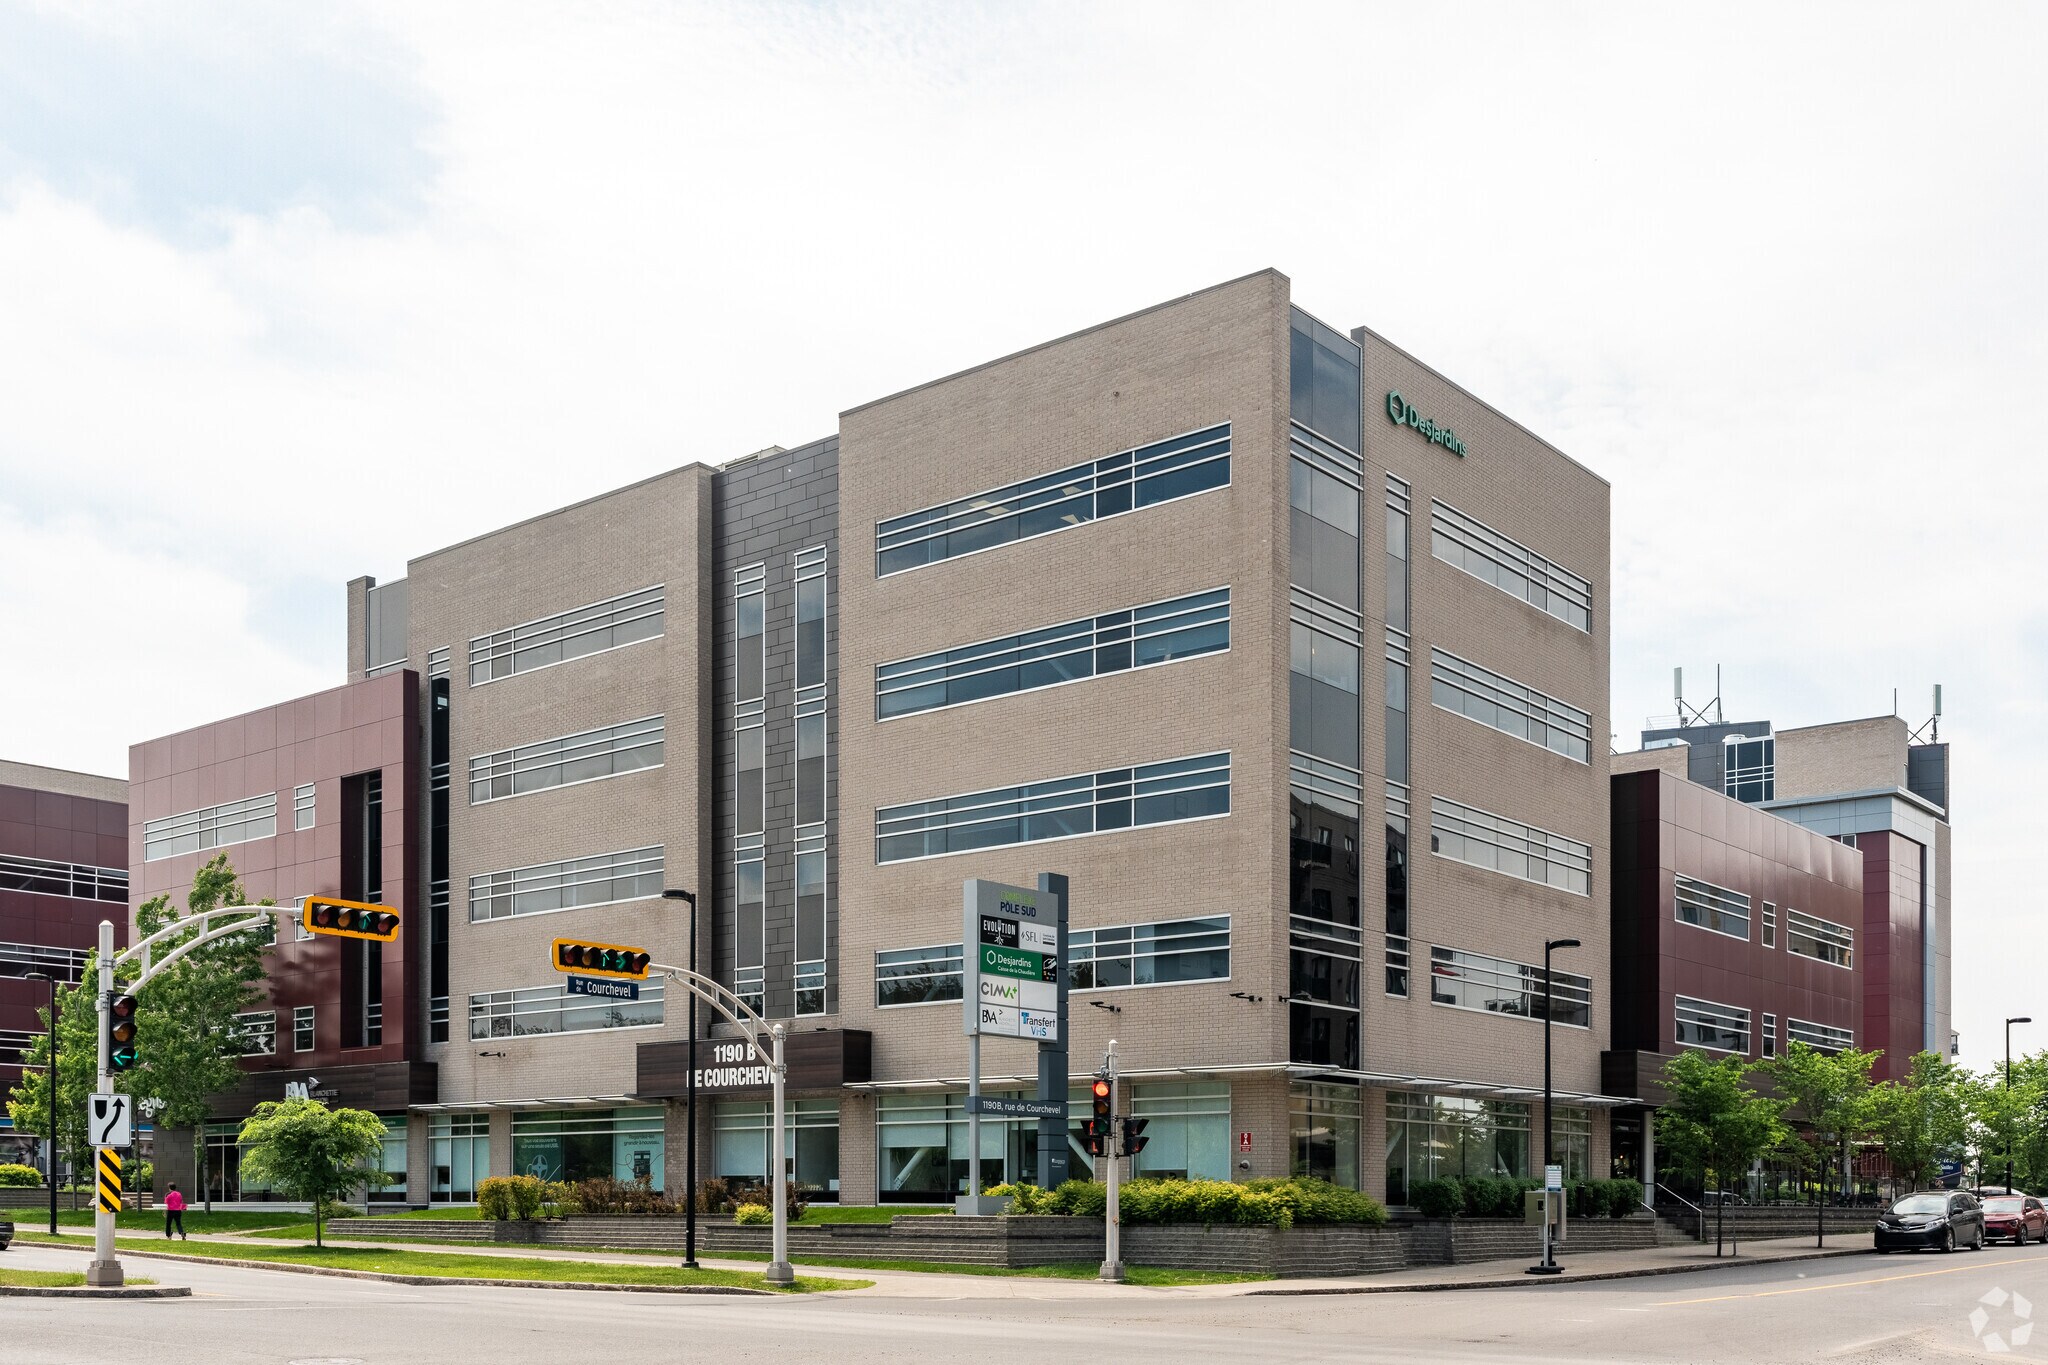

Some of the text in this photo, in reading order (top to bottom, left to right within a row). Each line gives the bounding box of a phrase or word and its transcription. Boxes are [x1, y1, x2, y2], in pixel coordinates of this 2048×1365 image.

[1406, 404, 1468, 458] Desjardins
[1000, 901, 1037, 917] PÔLE SUD
[1026, 930, 1038, 943] SFL
[997, 954, 1032, 968] Desjardins
[587, 981, 631, 997] Courchevel
[1021, 1011, 1056, 1028] Transfert
[713, 1043, 756, 1063] 1190 B
[686, 1065, 786, 1088] E COURCHEVE
[1004, 1103, 1015, 1111] rue
[1016, 1103, 1025, 1112] de
[1026, 1104, 1061, 1114] Courchevel
